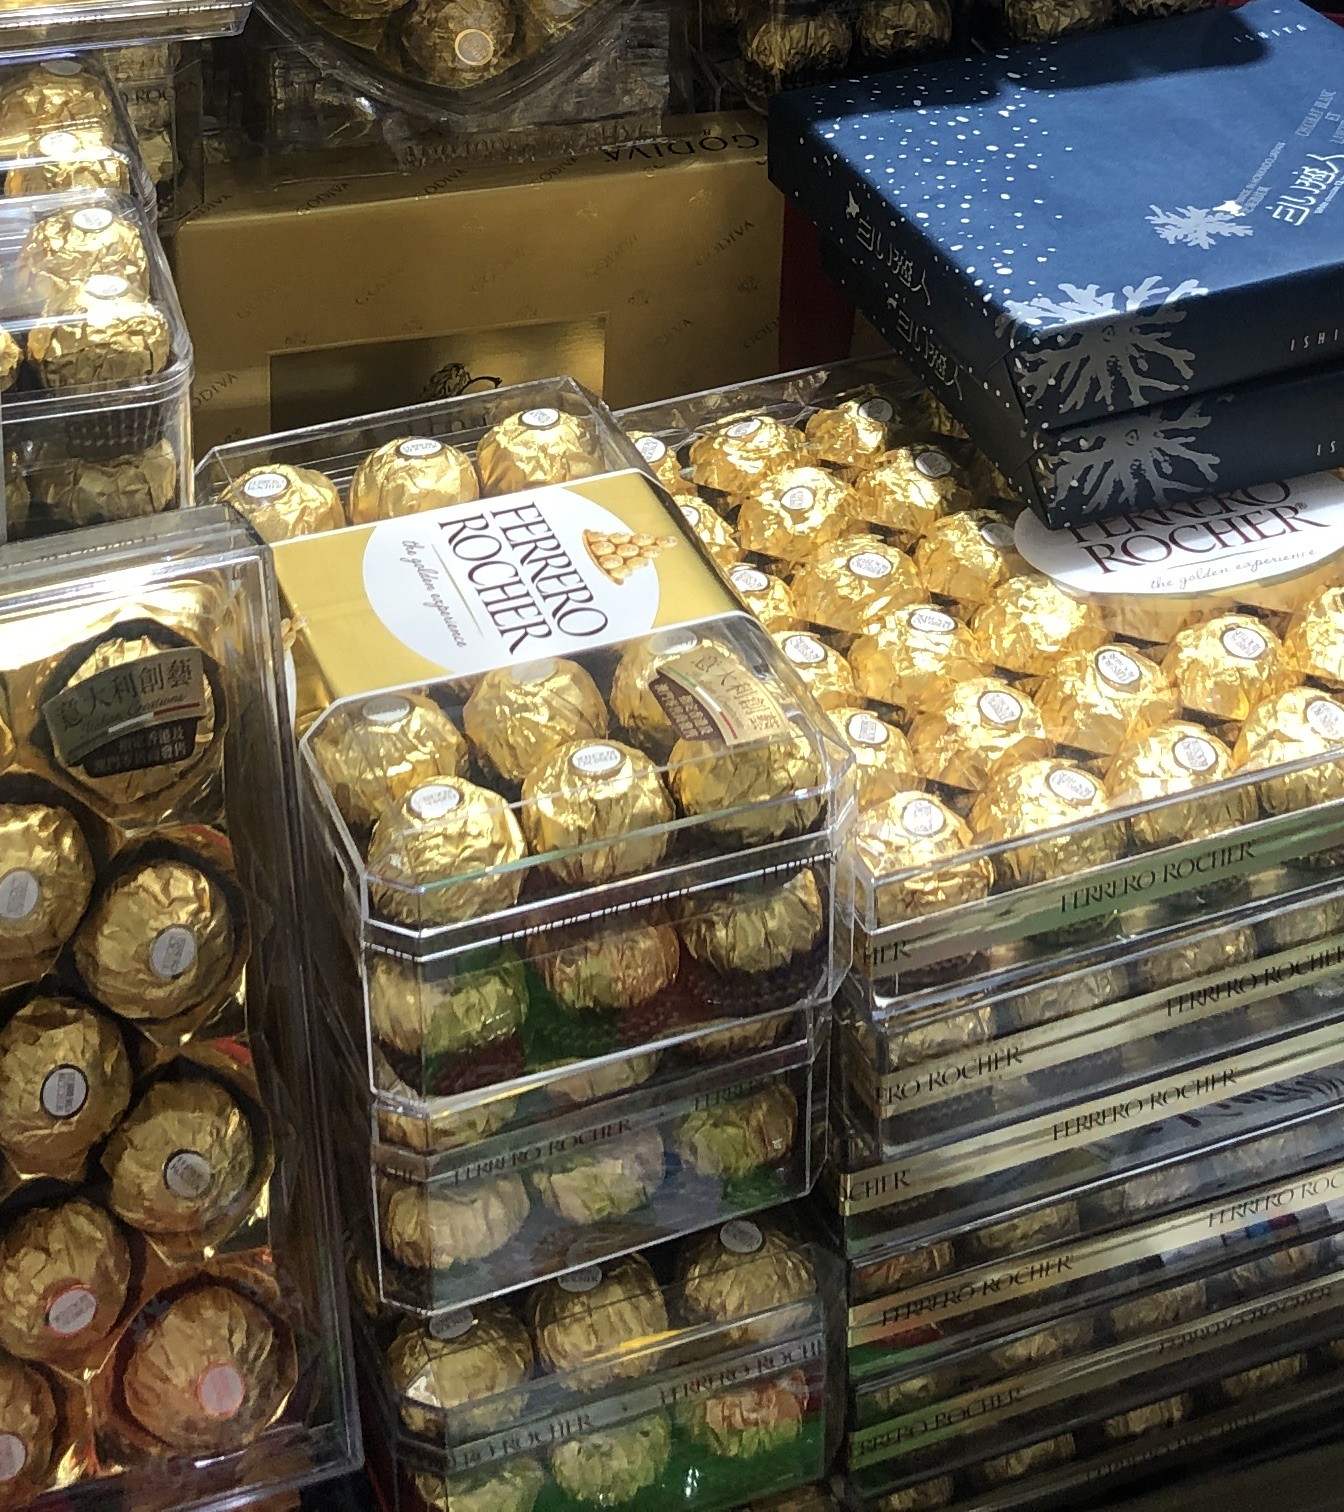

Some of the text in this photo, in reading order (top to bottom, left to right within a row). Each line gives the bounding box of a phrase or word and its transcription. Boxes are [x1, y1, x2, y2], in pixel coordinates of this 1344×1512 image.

[602, 132, 760, 163] GODIVA
[405, 554, 436, 604] golden
[422, 594, 469, 650] experience
[437, 513, 553, 656] ROCHER
[490, 499, 610, 640] FERRERO
[1150, 573, 1175, 591] the
[1177, 565, 1231, 593] golden
[1060, 838, 1256, 913] FERRERO ROCHER
